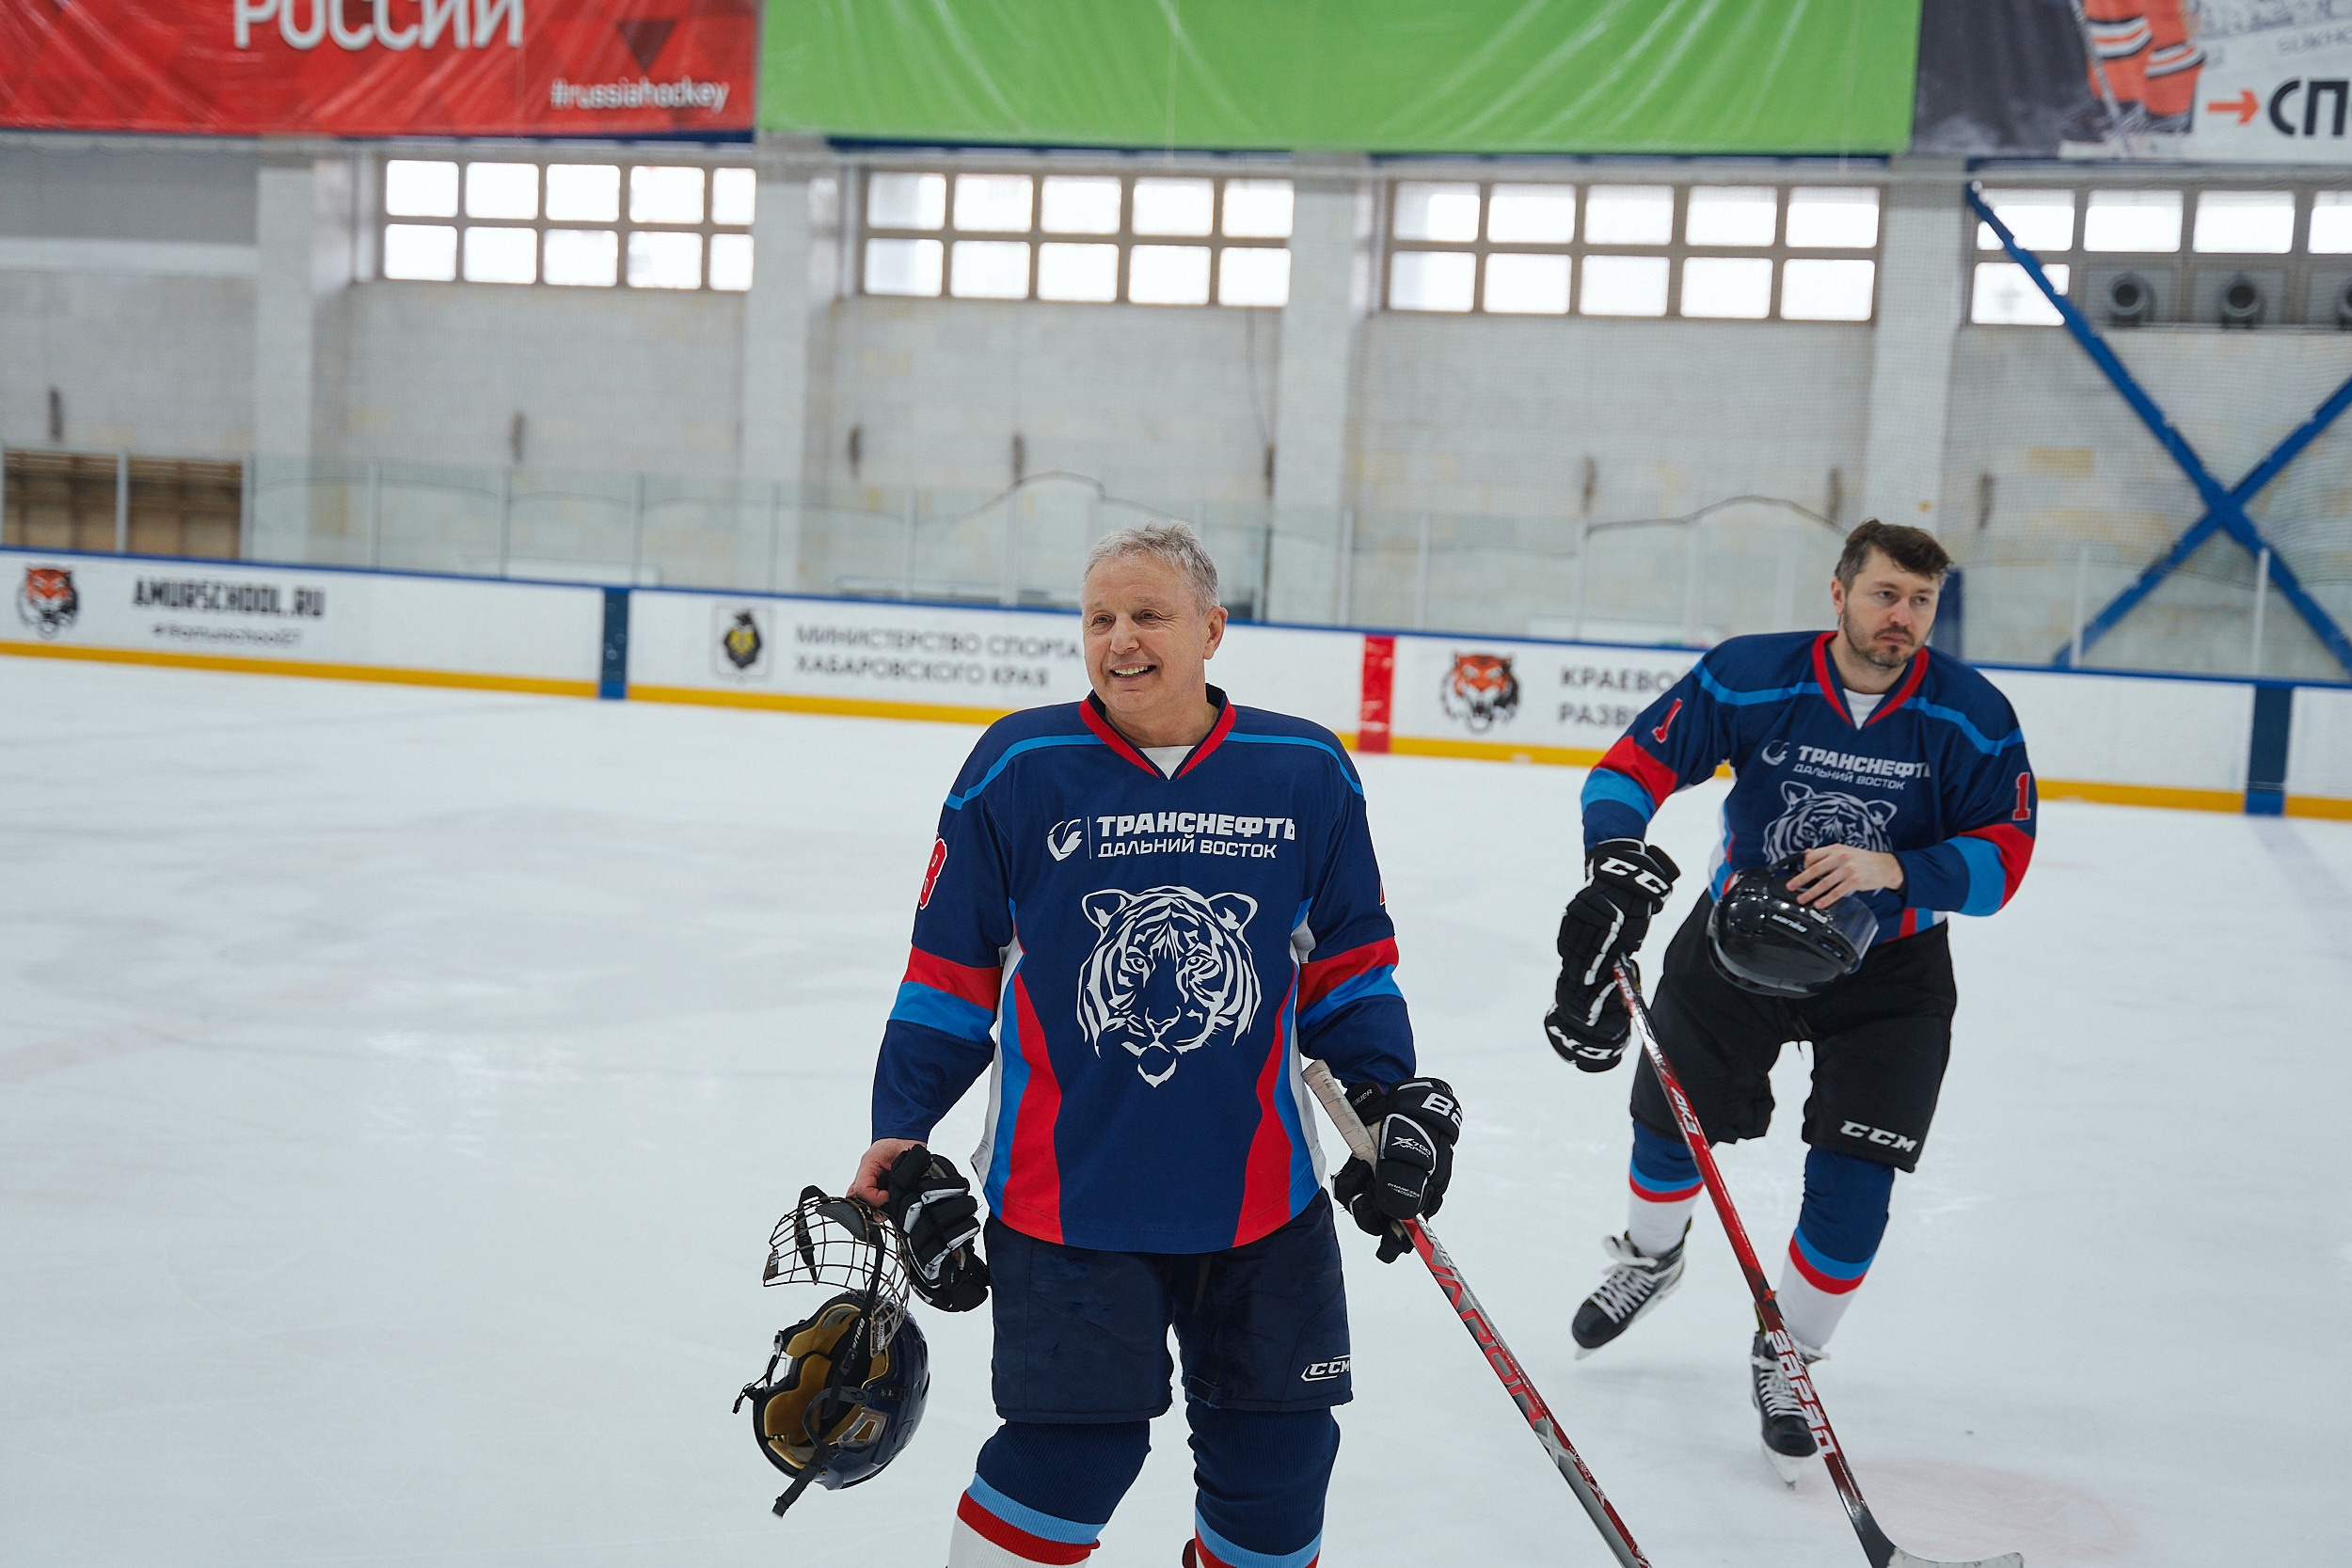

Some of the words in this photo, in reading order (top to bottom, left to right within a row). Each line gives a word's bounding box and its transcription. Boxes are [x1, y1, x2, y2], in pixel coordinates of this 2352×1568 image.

[233, 0, 524, 51] РОССИИ
[550, 77, 730, 114] #russiahockey
[2268, 77, 2352, 137] СП
[132, 579, 326, 618] AMURSCHOOL.RU
[796, 625, 984, 657] МИНИСТЕРСТВО
[987, 634, 1080, 661] СПОРТА
[796, 656, 986, 686] ХАБАРОВСКОГО
[993, 665, 1050, 688] КРАЯ
[1561, 664, 1692, 693] КРАЕВО
[1651, 698, 1683, 743] 1
[1791, 762, 1854, 784] ДАЛЬНИЙ
[1855, 776, 1907, 790] ВОСТОК
[2011, 771, 2031, 821] 1
[1096, 811, 1296, 841] ТРАНСНЕФТЬ
[1097, 833, 1195, 858] ДАЛЬНИЙ
[1199, 840, 1279, 859] ВОСТОК
[1839, 1119, 1918, 1153] CCM
[1422, 1242, 1546, 1431] VAPOR
[1309, 1360, 1350, 1376] CCM
